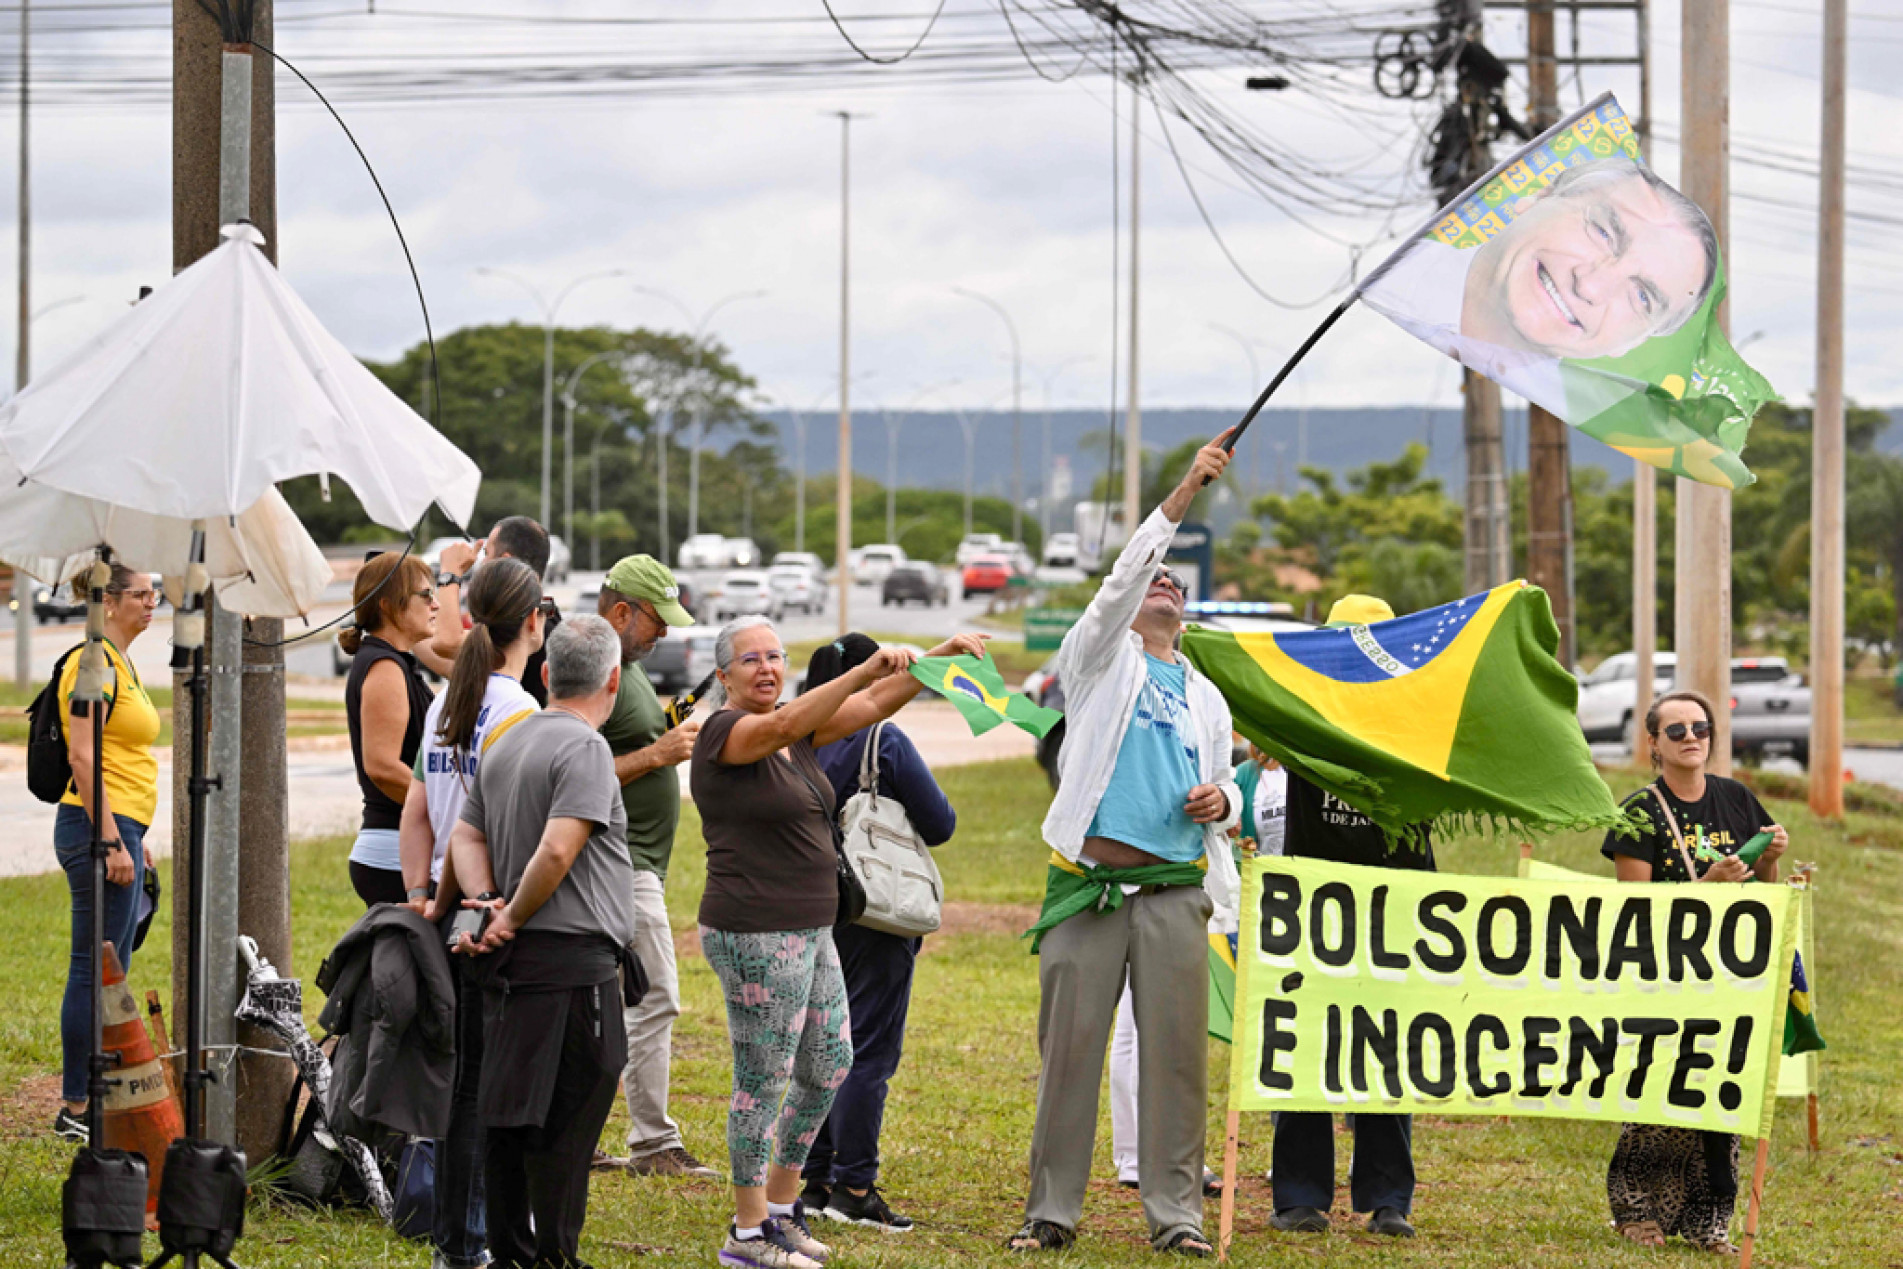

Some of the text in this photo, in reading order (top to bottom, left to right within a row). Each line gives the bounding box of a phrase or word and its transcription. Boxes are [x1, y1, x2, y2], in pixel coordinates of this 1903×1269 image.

[1506, 165, 1527, 188] 22
[1440, 218, 1461, 241] 22
[1261, 872, 1773, 982] BOLSONARO
[1259, 971, 1754, 1111] É INOCENTE!
